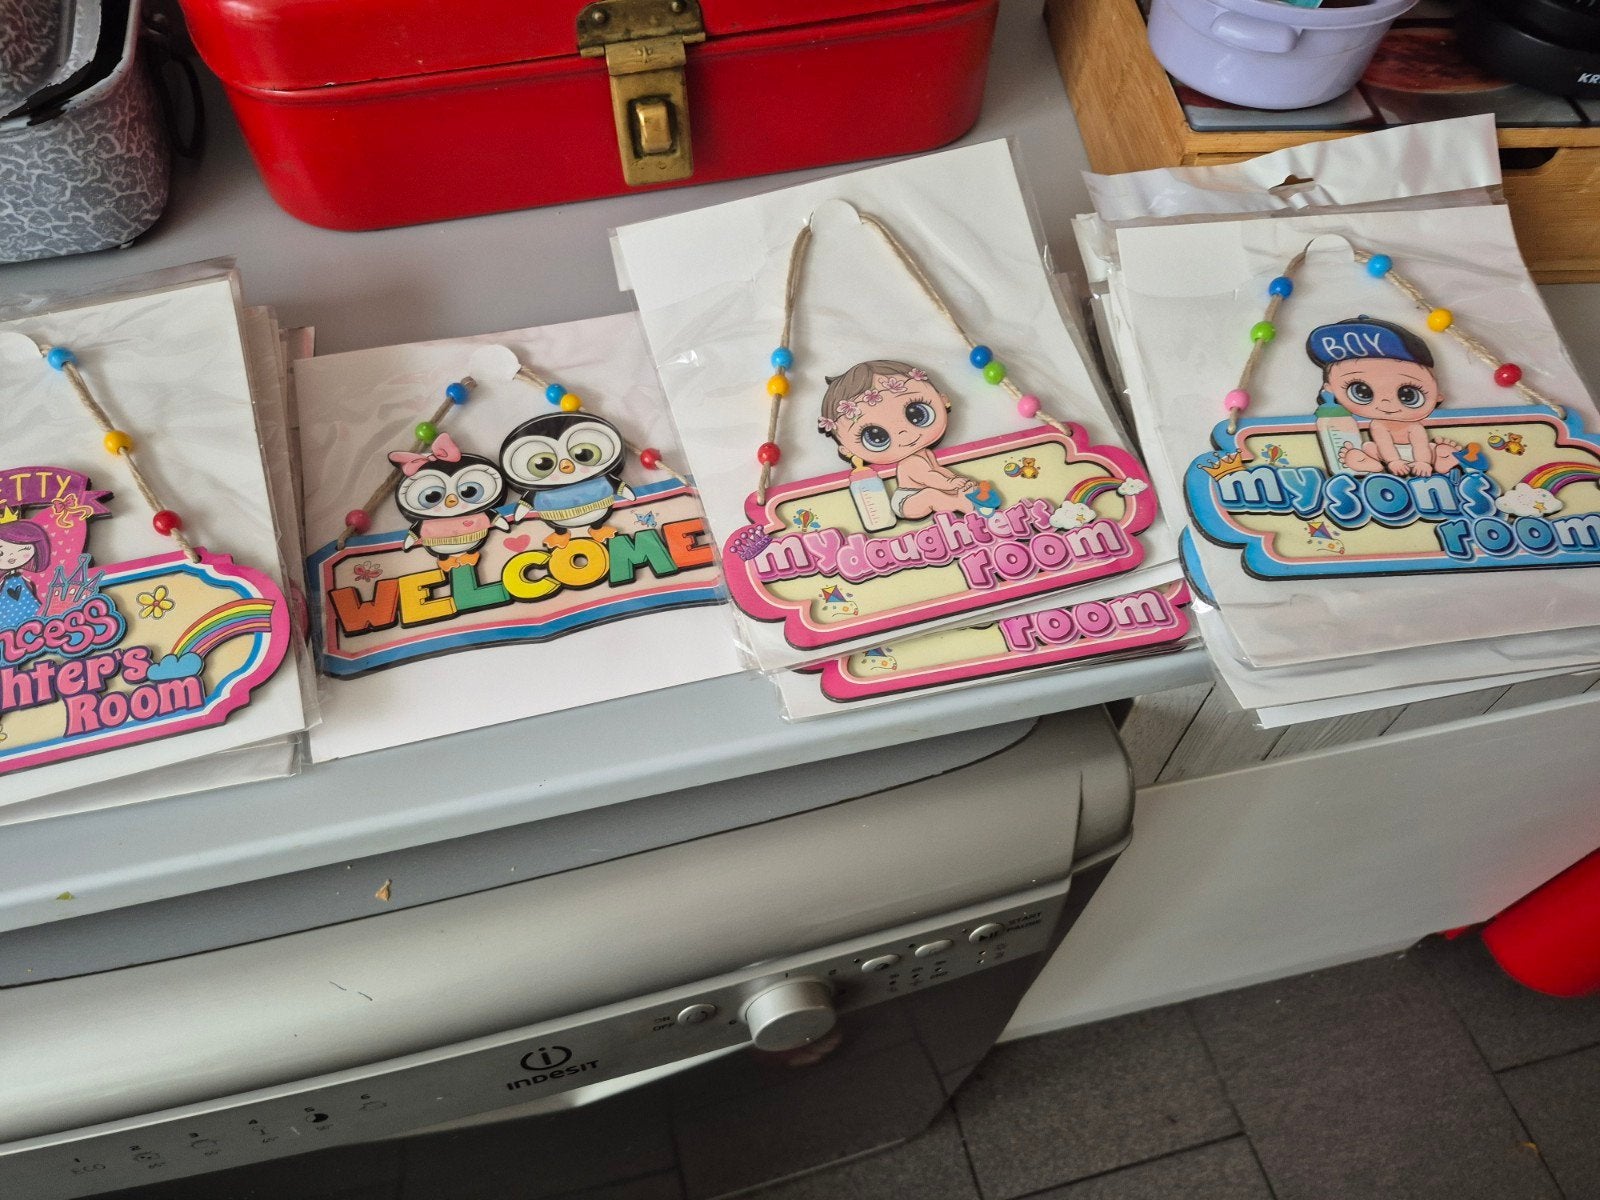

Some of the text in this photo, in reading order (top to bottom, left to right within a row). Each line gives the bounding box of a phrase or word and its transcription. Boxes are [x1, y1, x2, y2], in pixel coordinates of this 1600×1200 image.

[1577, 72, 1600, 84] KR
[1321, 332, 1385, 361] BOY
[0, 471, 72, 504] TTY
[1218, 467, 1498, 529] my son's
[754, 499, 1053, 582] my daughter's
[961, 522, 1124, 589] room
[1439, 513, 1600, 562] room
[328, 519, 715, 636] WELCOME
[1002, 590, 1176, 651] room
